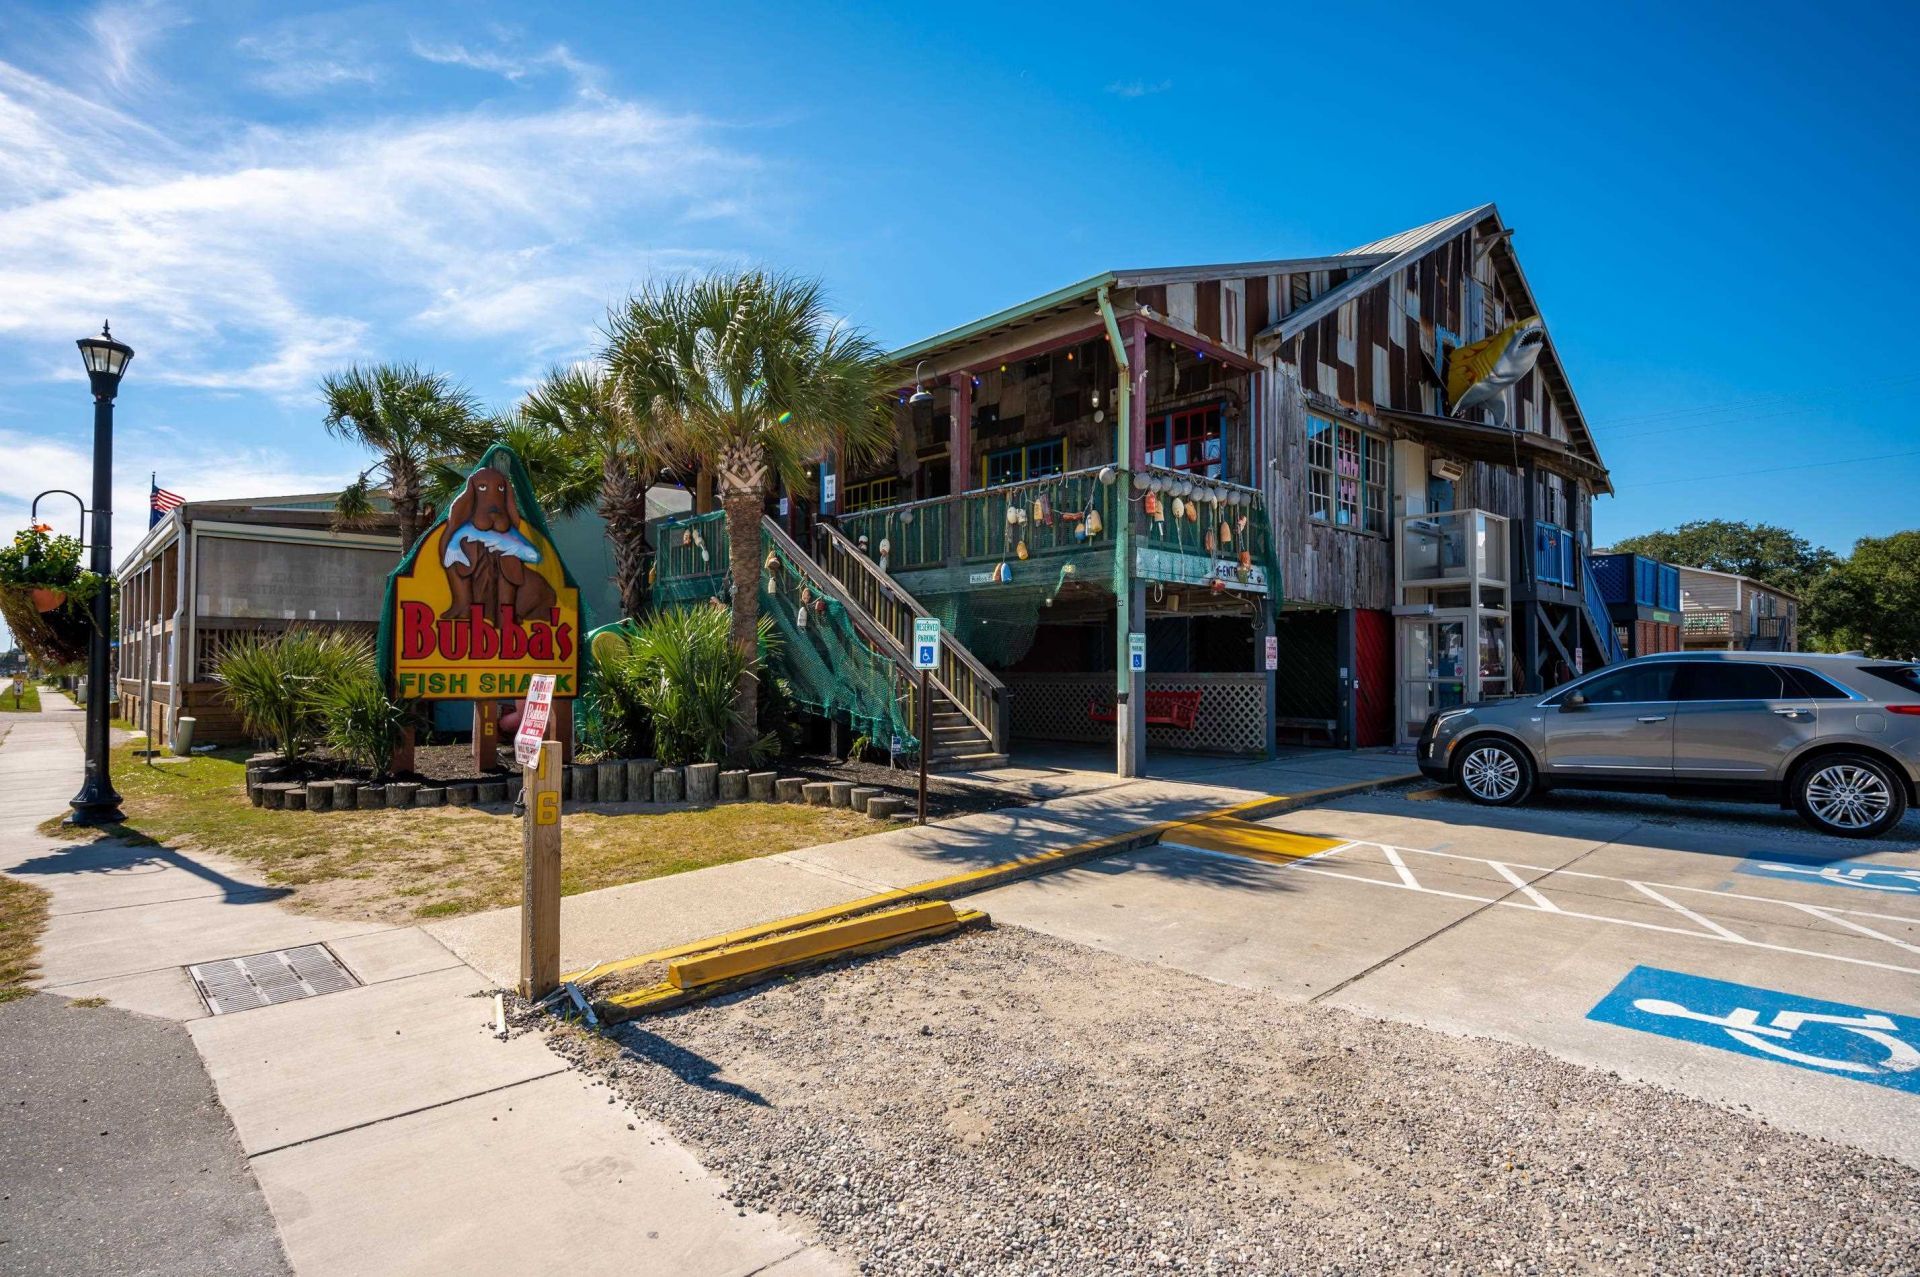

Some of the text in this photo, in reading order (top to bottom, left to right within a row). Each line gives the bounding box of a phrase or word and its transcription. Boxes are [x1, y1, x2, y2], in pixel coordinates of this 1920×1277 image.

[400, 601, 573, 662] Bubba's
[917, 634, 936, 642] PARKING
[400, 673, 573, 693] FISH SHAK
